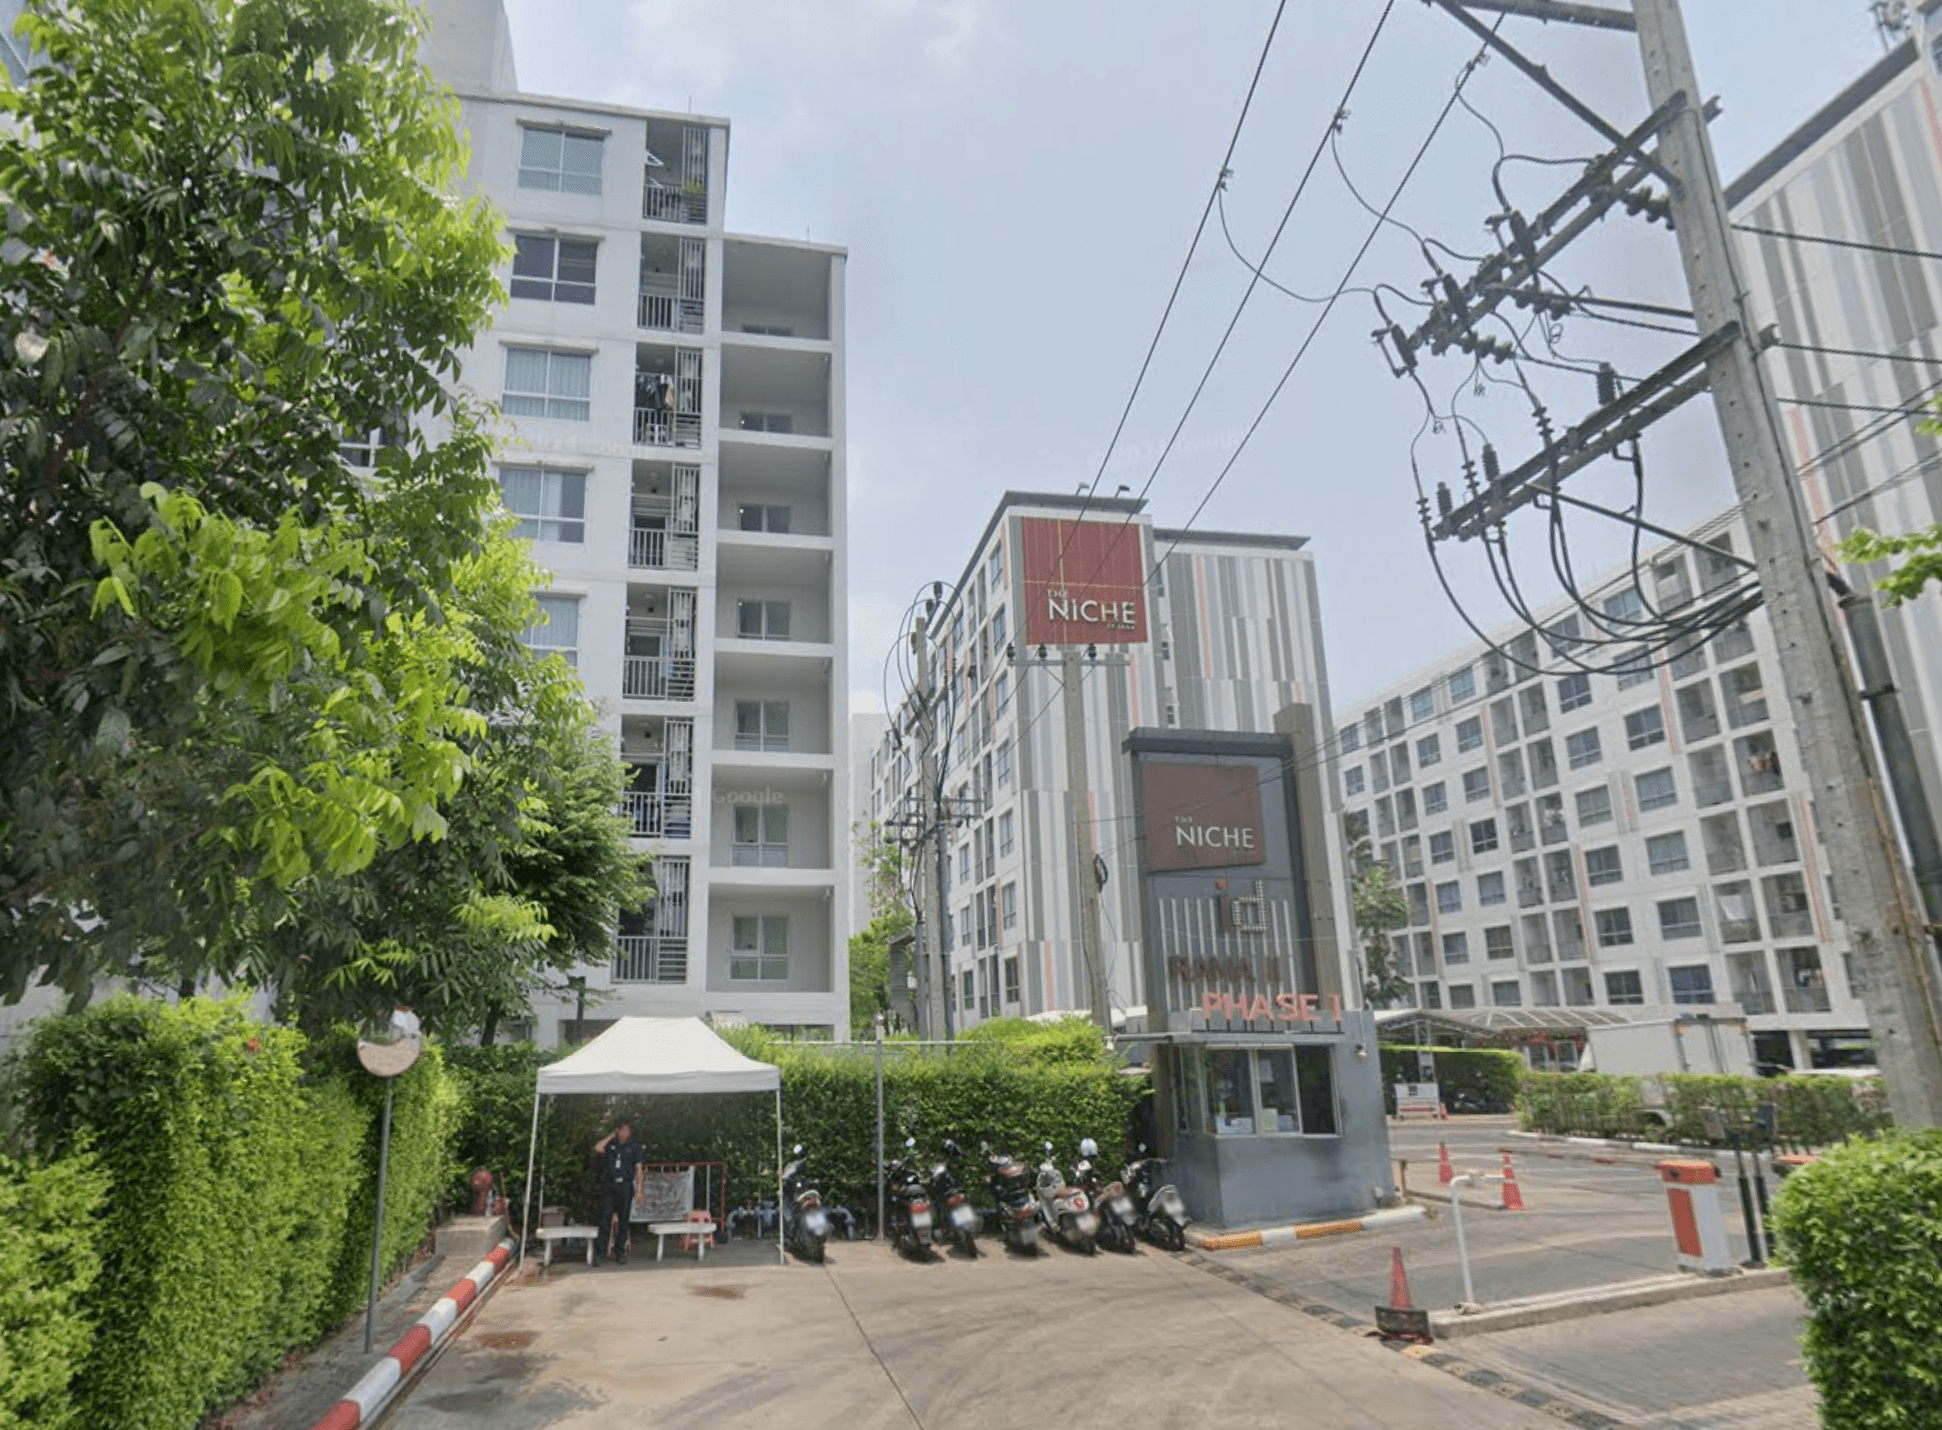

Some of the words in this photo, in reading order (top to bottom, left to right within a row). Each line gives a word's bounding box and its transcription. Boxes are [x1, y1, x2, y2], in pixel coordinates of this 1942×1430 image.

[1048, 598, 1136, 625] NICHE
[1175, 826, 1255, 848] NICHE
[1203, 993, 1320, 1021] PHASE
